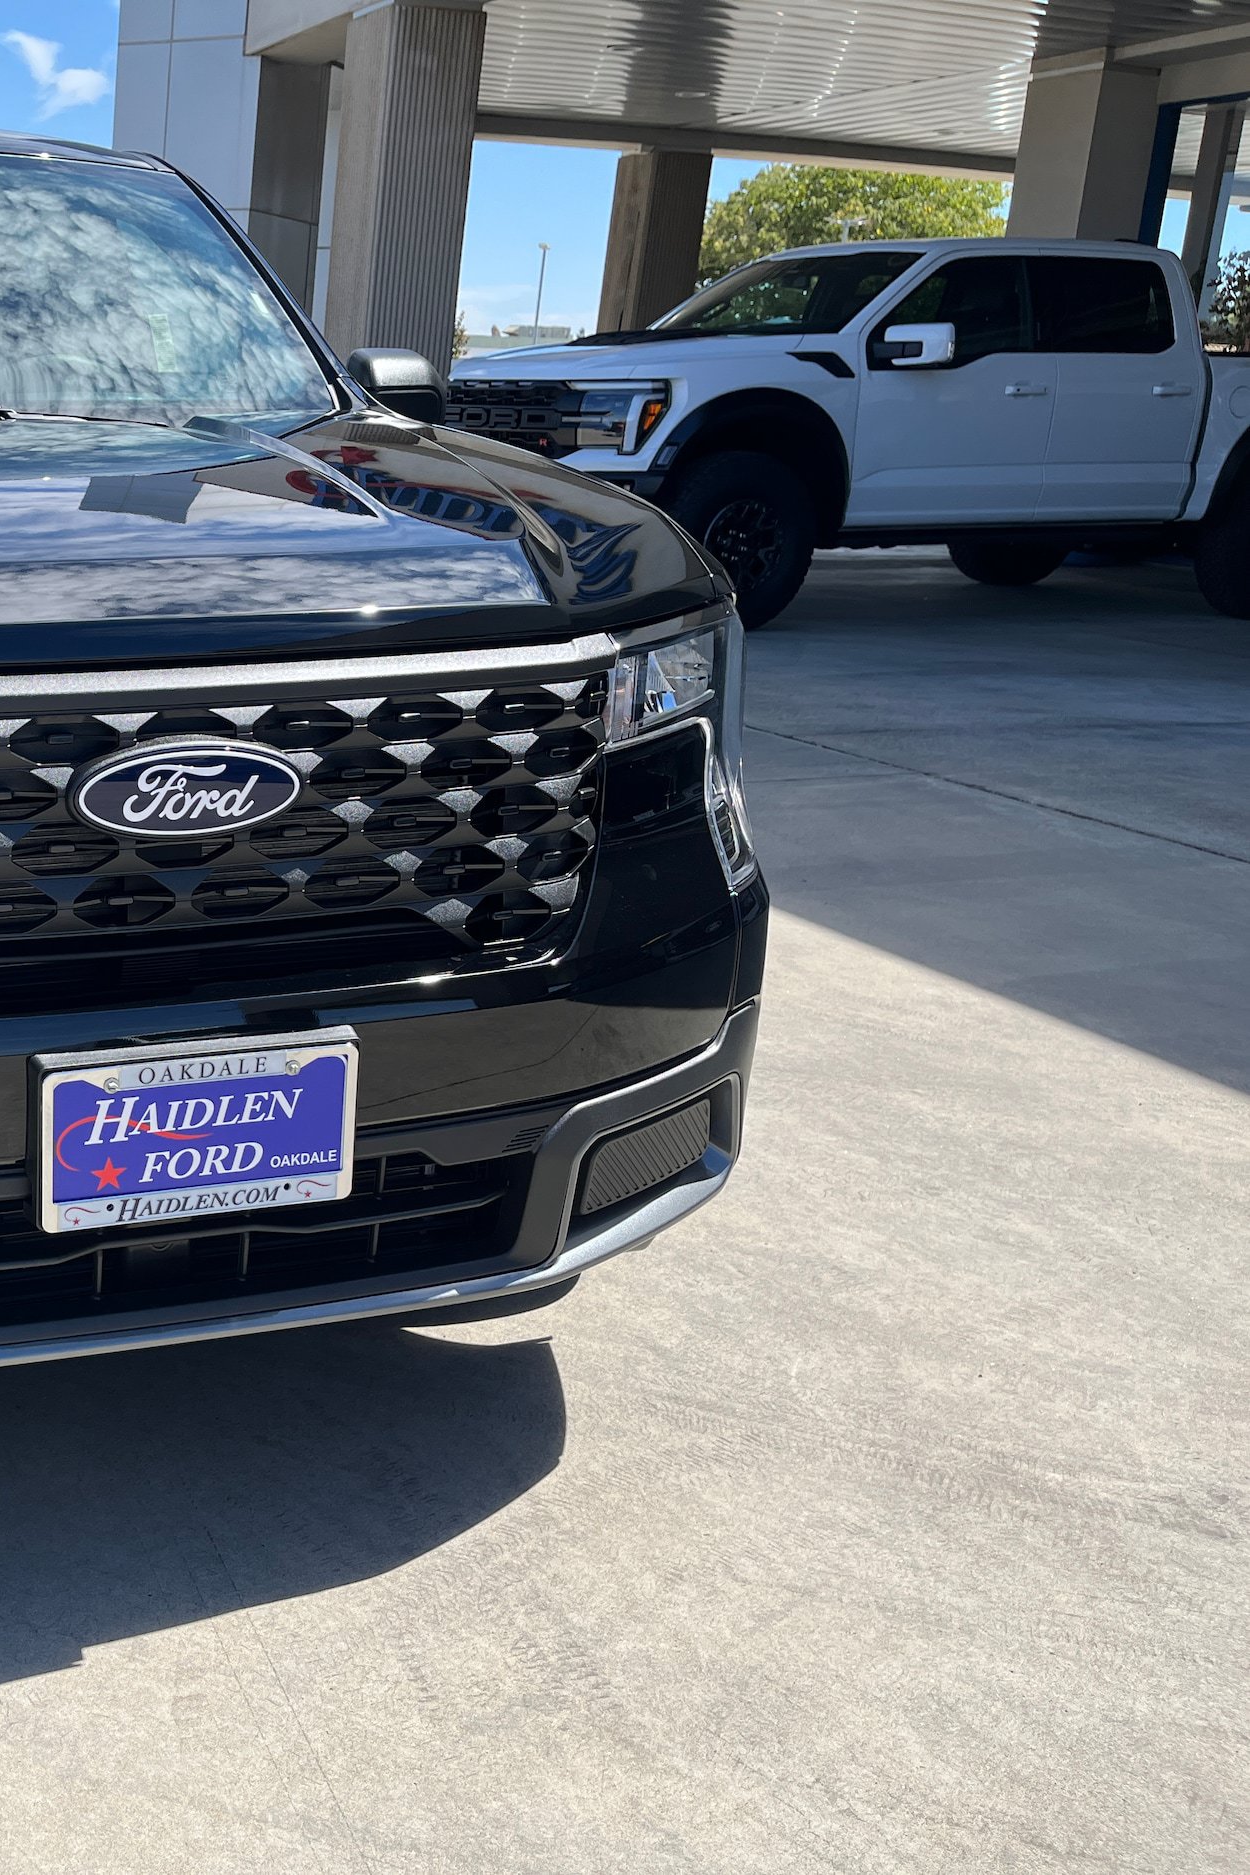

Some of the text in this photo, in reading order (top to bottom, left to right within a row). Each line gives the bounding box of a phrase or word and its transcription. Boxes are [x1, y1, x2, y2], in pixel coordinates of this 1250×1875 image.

[122, 763, 260, 823] Ford
[138, 1056, 267, 1085] OAKDALE
[83, 1088, 303, 1146] HAIDLEN
[138, 1141, 338, 1183] FORD OAKDALE
[115, 1185, 281, 1223] HAIDLEN.COM
